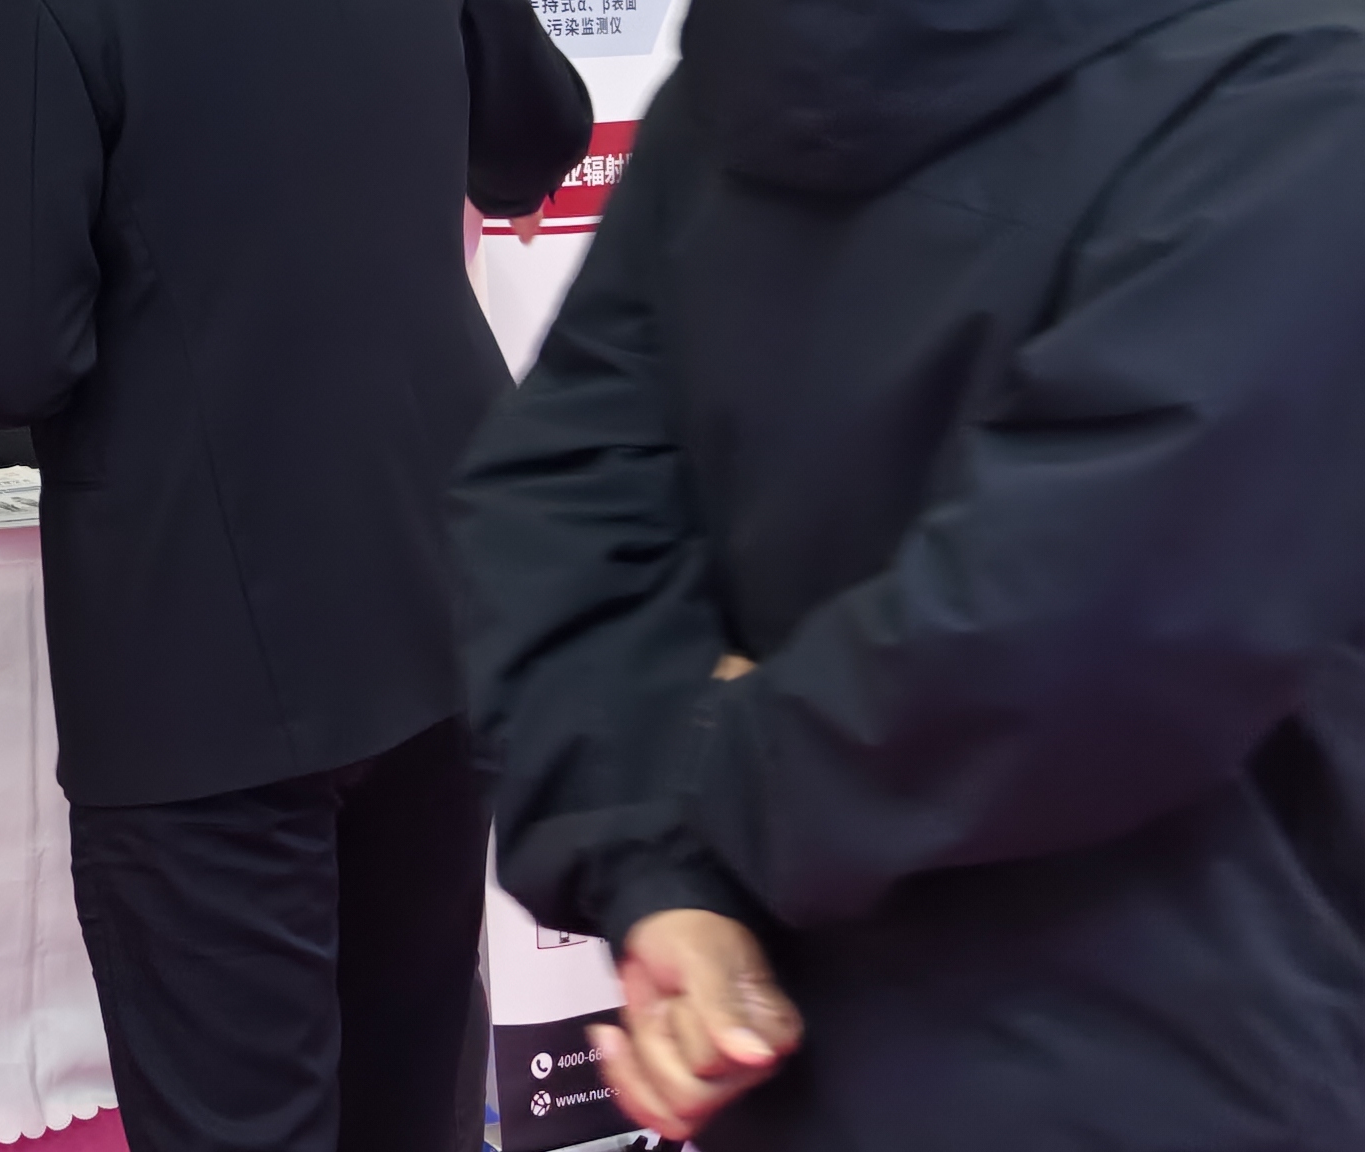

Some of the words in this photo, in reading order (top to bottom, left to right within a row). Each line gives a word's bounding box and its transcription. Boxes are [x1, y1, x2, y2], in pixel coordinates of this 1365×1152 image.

[547, 17, 622, 37] 污染监测仪
